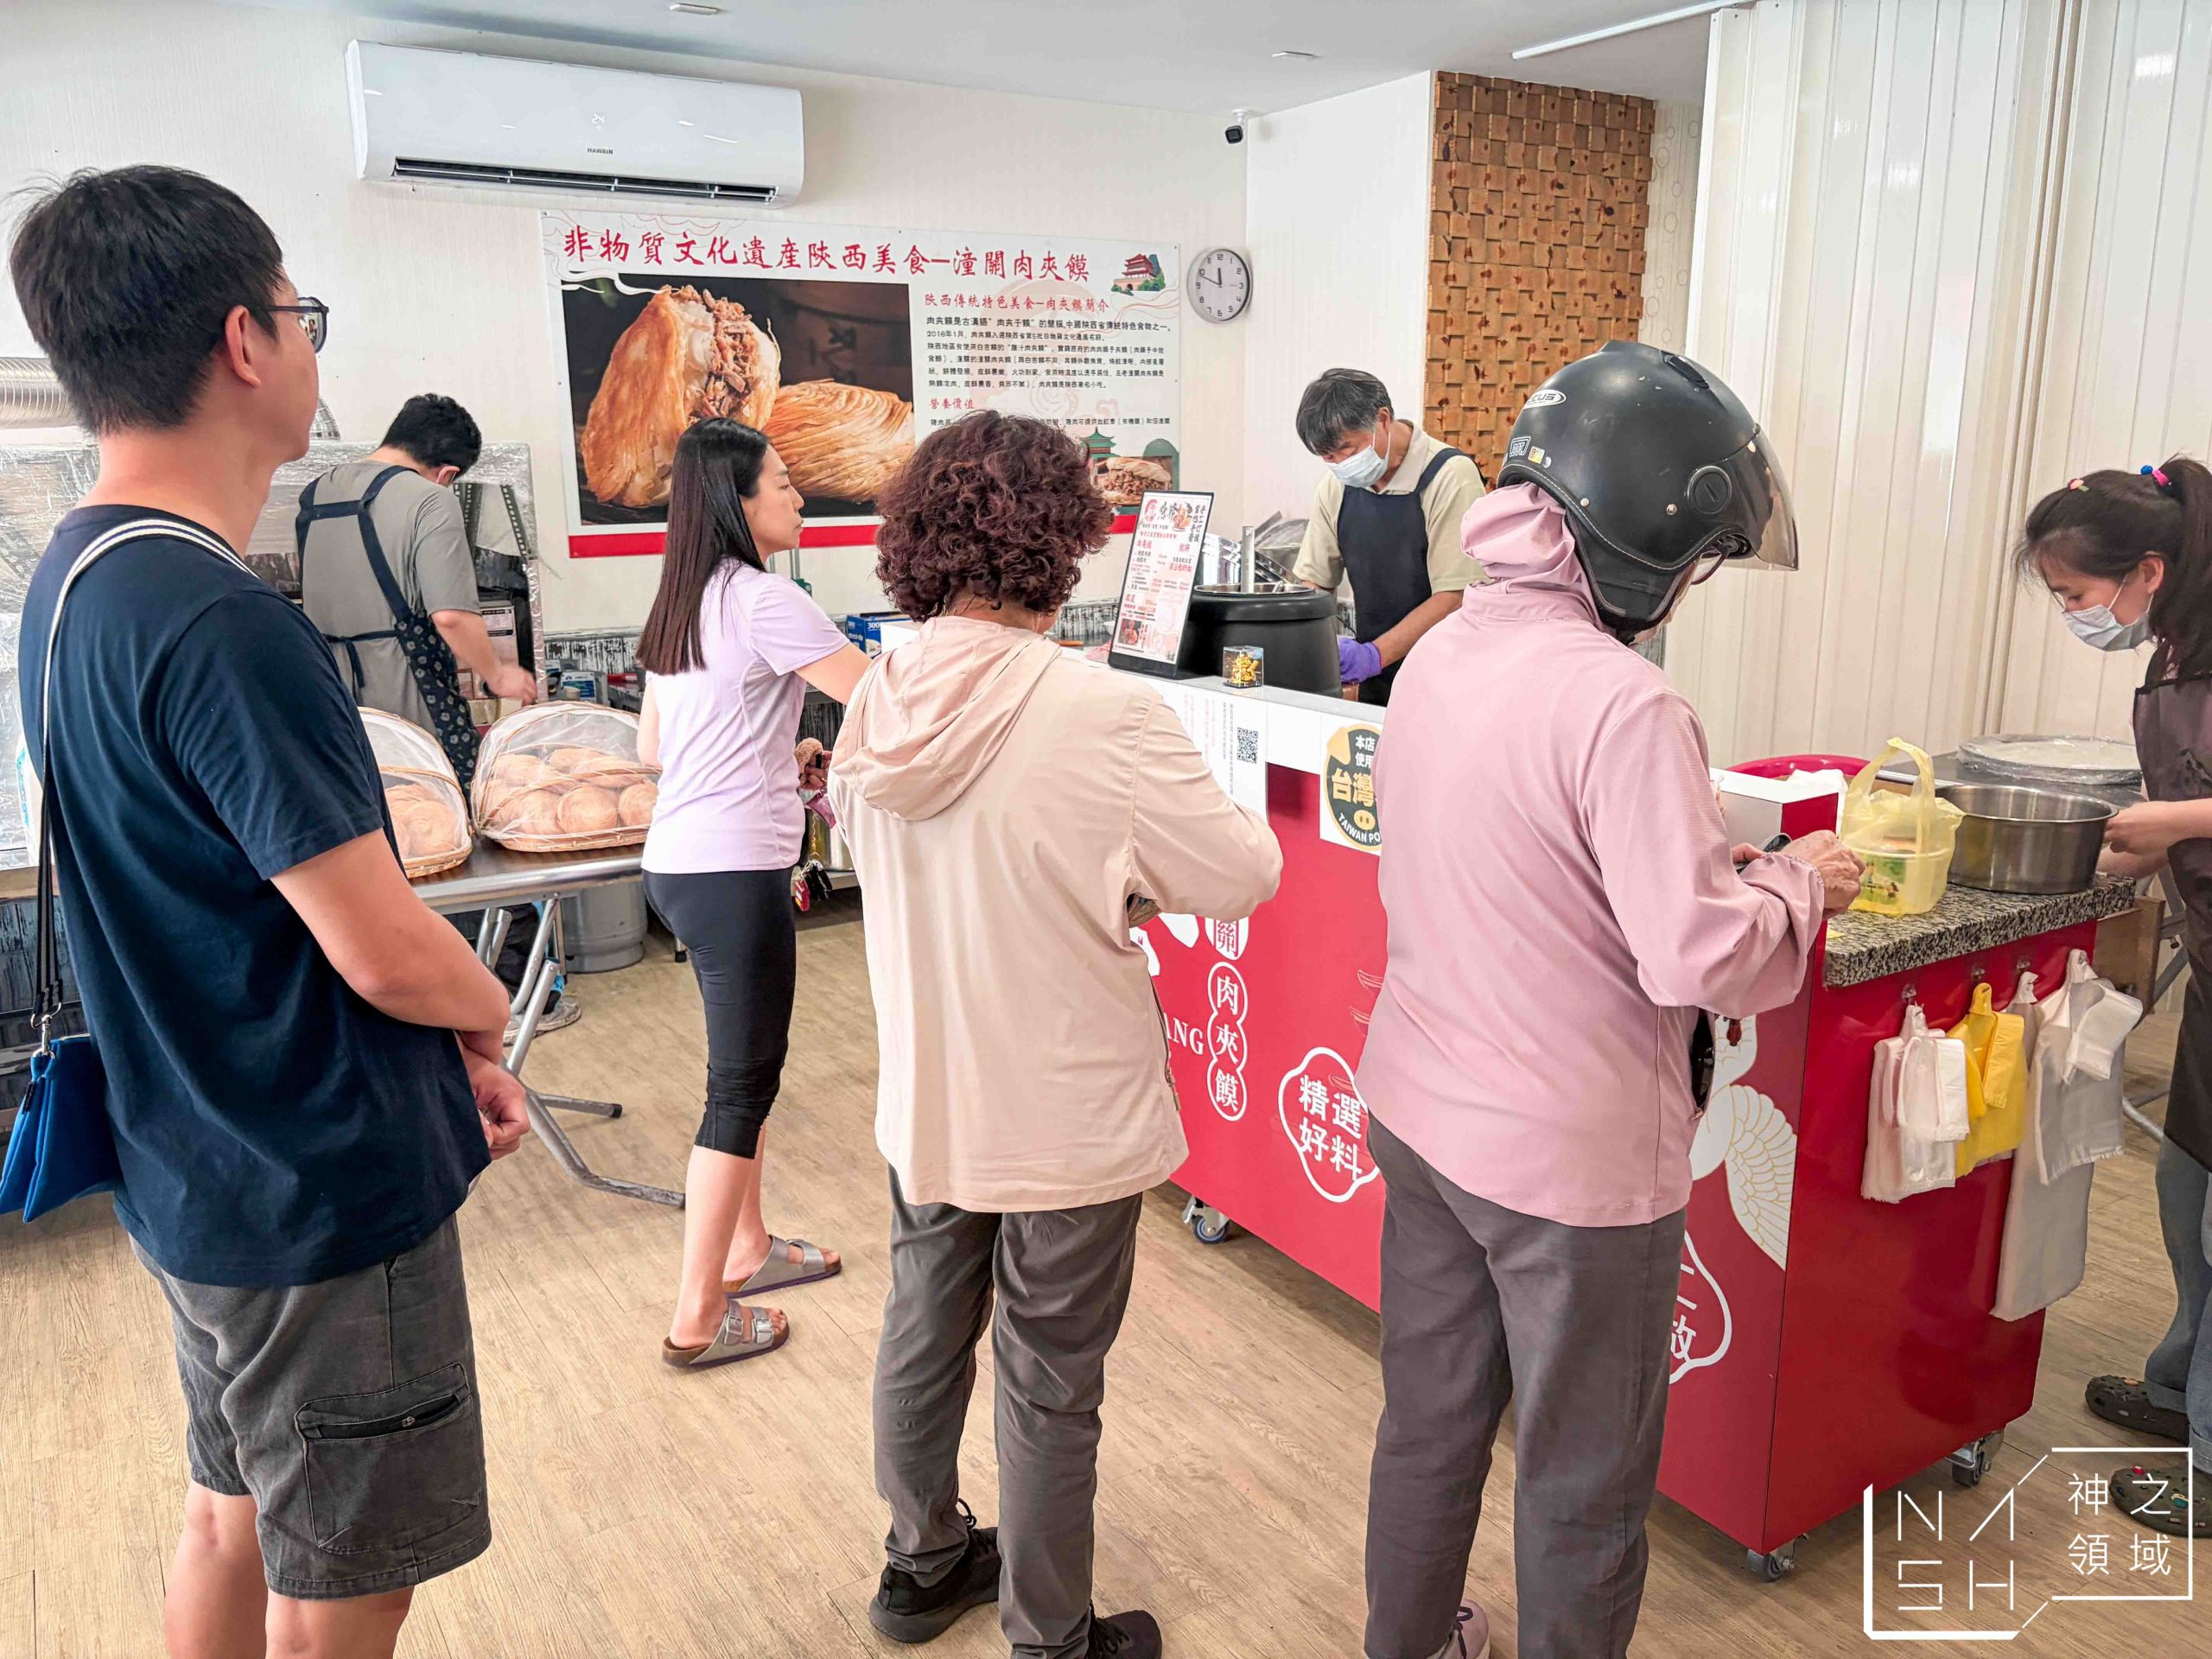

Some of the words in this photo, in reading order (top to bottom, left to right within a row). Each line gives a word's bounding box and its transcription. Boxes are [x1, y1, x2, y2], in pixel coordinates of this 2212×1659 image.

[591, 113, 605, 124] 24
[1355, 734, 1376, 752] 本店
[1338, 812, 1367, 843] TAIWAN
[1299, 1074, 1362, 1140] 精選
[1299, 1117, 1363, 1182] 好料
